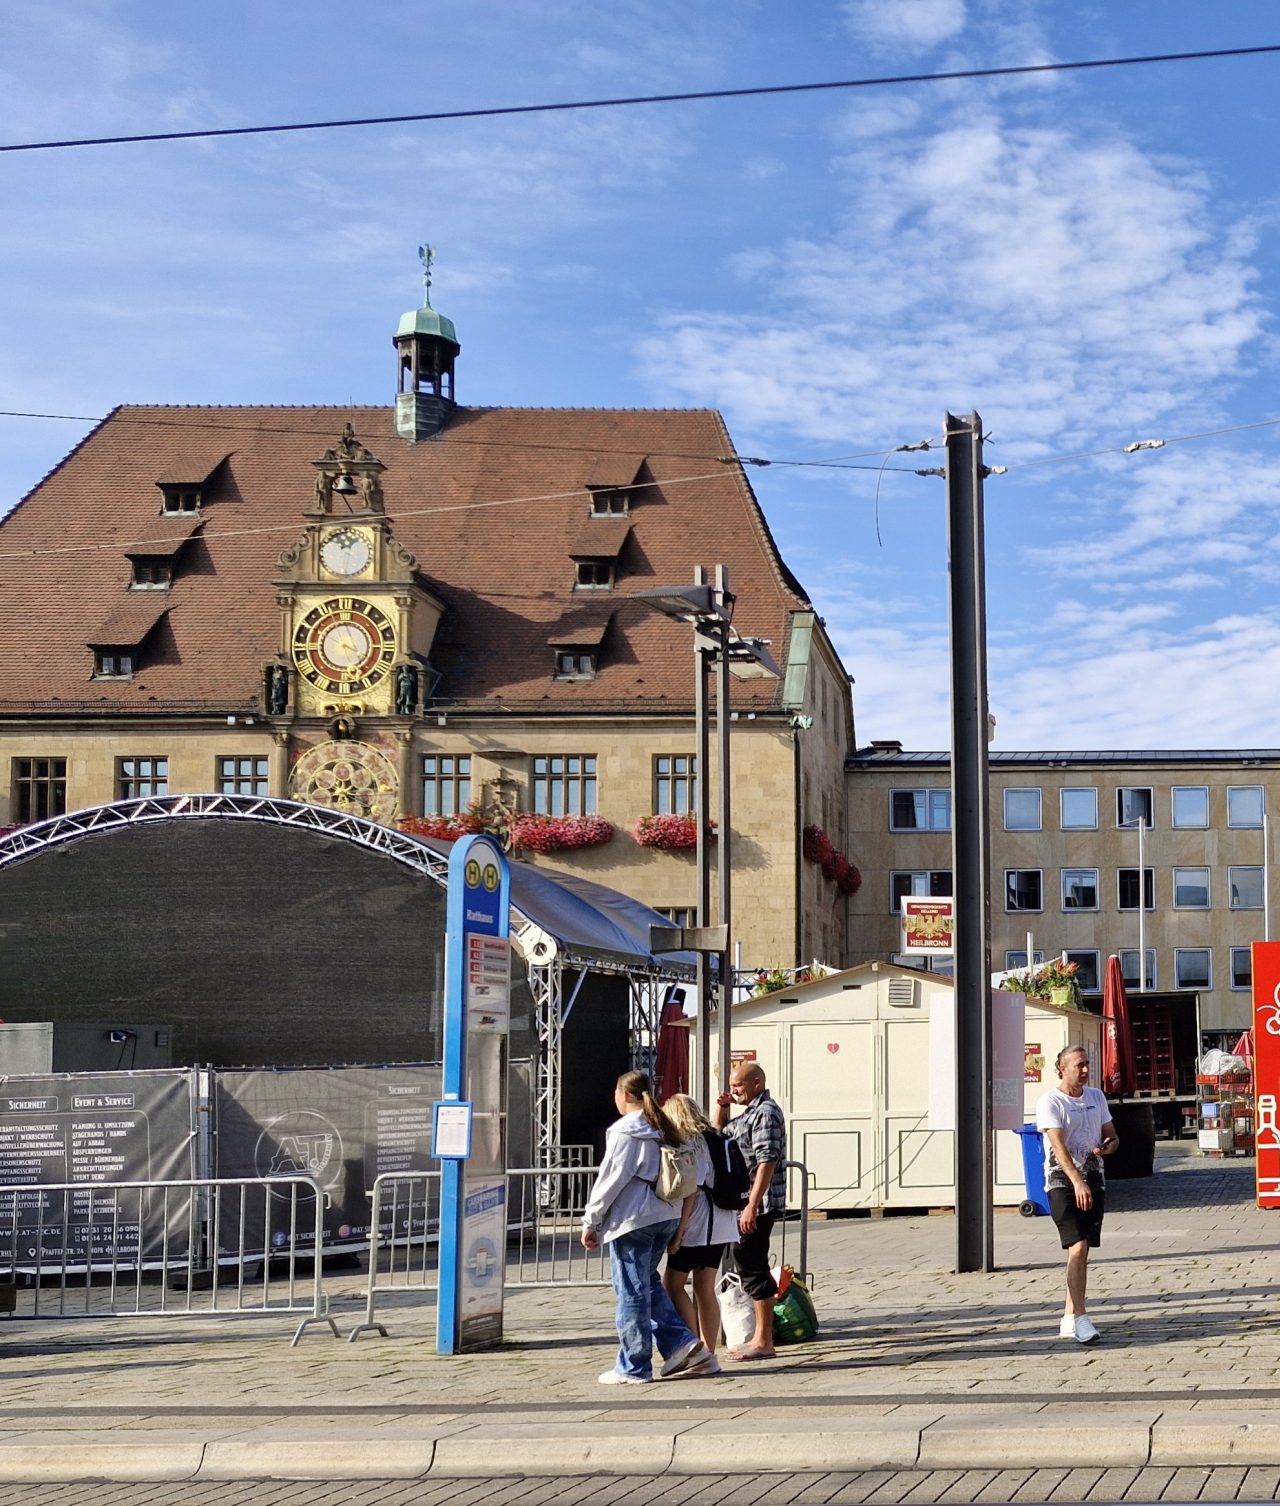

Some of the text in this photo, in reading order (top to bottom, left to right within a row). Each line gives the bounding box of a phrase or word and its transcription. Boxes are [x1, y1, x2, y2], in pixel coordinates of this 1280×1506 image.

[910, 939, 949, 947] HEILBRONN
[8, 1100, 47, 1110] SICHERHEIT
[81, 1226, 100, 1234] 0731
[81, 1234, 100, 1242] 0114
